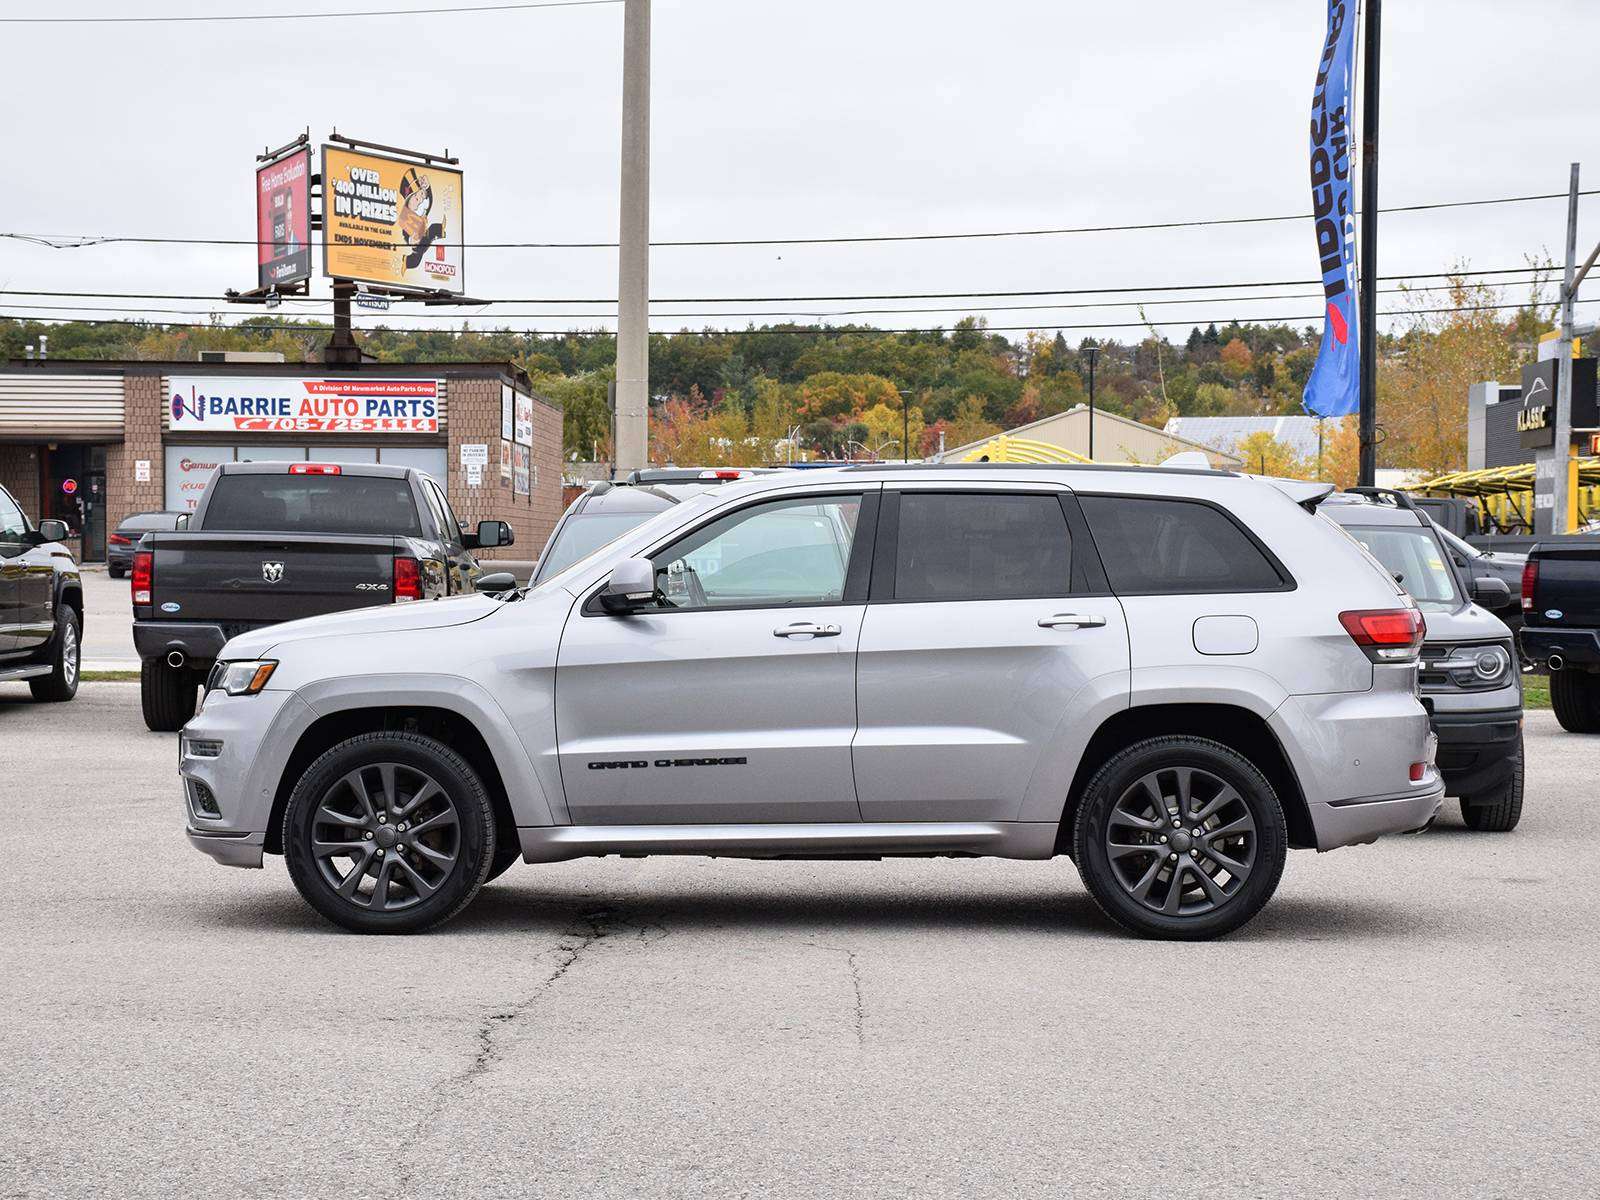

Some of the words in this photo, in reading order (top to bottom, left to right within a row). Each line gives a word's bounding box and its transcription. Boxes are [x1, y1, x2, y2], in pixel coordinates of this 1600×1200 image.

[350, 166, 380, 184] OVER
[356, 182, 397, 203] MILLION
[335, 194, 351, 215] IN
[352, 197, 397, 223] PRIZES
[335, 233, 352, 244] ENDS
[353, 236, 391, 250] NOVEMBER
[425, 262, 456, 275] MONOPOLY
[209, 396, 291, 416] BARRIE
[298, 398, 359, 417] AUTO
[366, 399, 435, 418] PARTS
[266, 418, 432, 431] 705-725-1114
[1517, 405, 1547, 432] KLASSIC
[588, 760, 649, 770] GRAND
[654, 757, 748, 768] CHEROKEE
